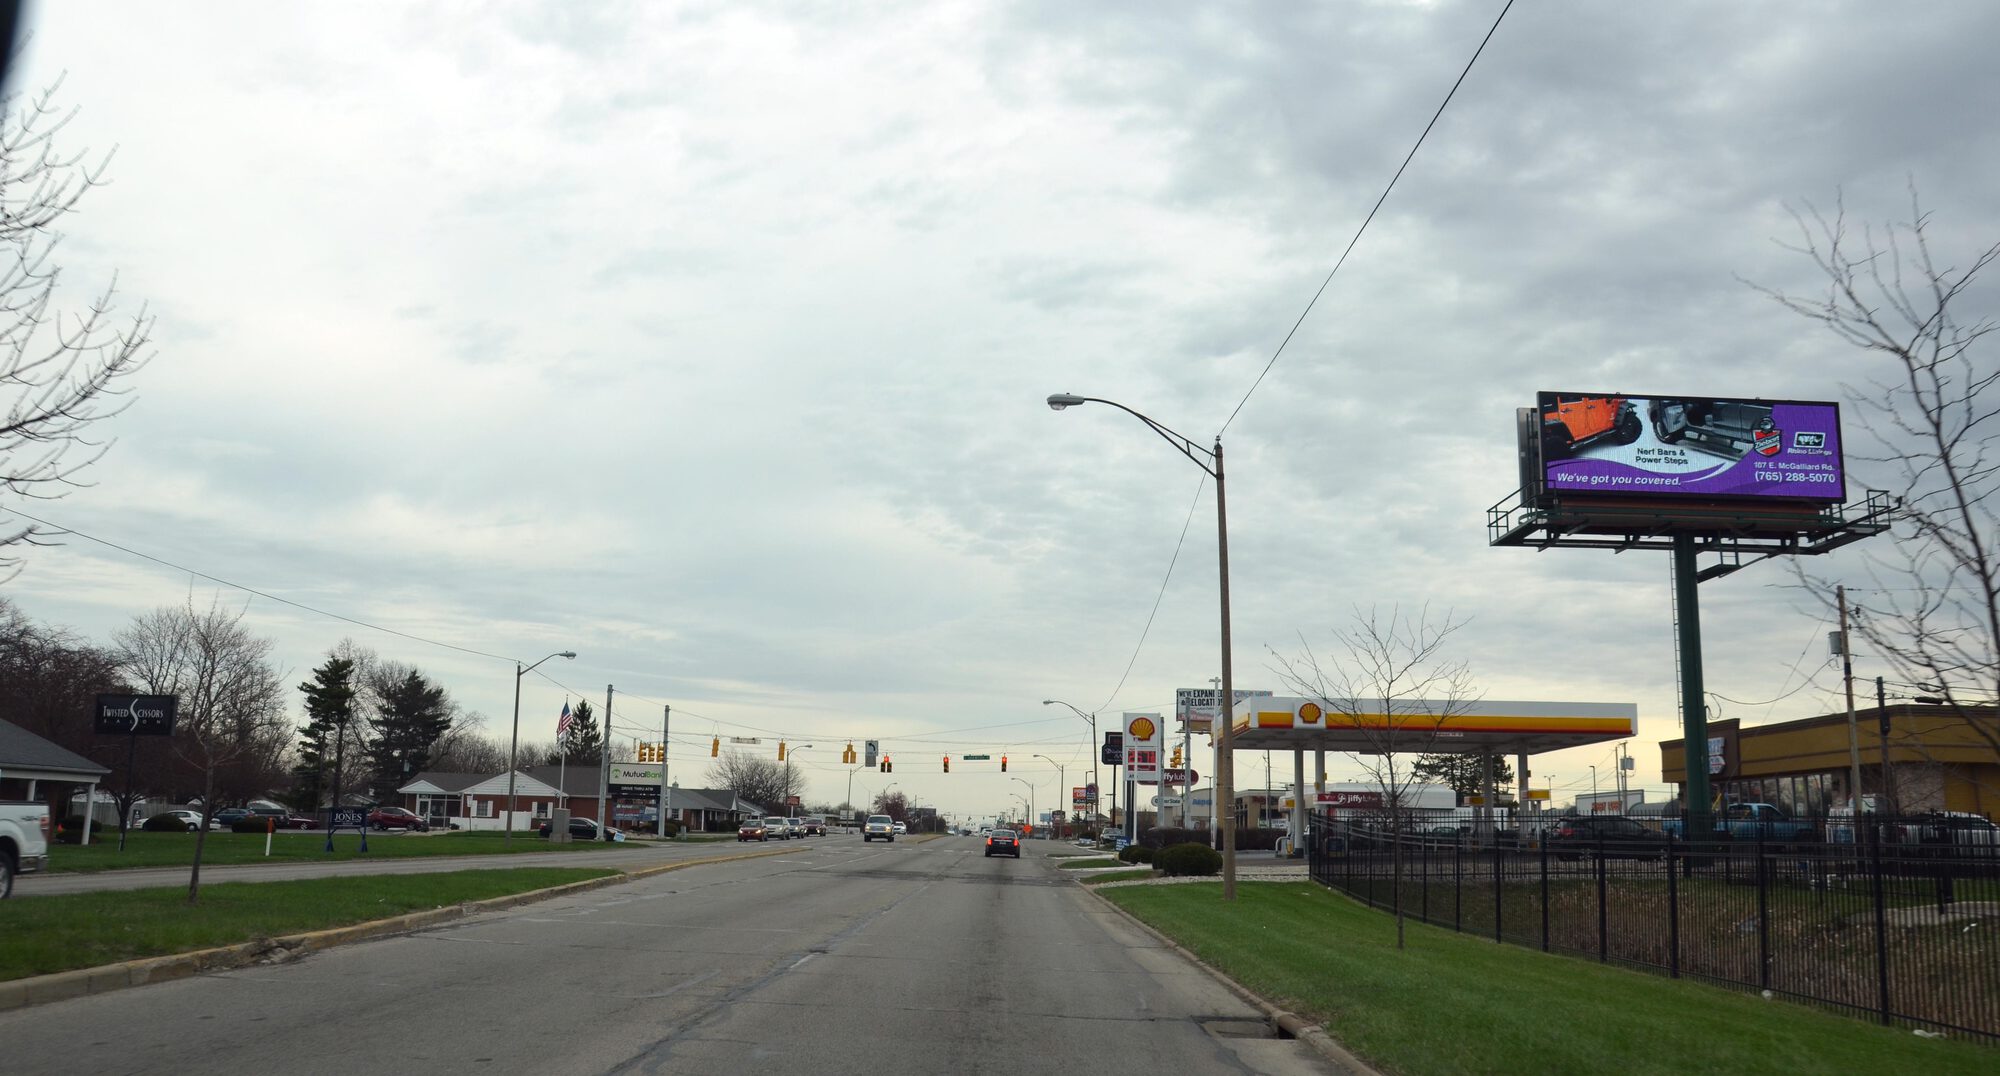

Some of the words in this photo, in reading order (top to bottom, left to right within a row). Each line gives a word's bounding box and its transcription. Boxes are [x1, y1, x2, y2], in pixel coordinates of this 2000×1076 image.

[1637, 447, 1655, 455] Nerf
[1658, 448, 1677, 456] Bars
[1635, 456, 1662, 464] Power
[1664, 457, 1689, 465] Steps
[1557, 472, 1589, 482] We've
[1591, 474, 1609, 485] got
[1611, 475, 1632, 485] you
[1634, 476, 1682, 486] covered.
[1755, 470, 1783, 482] (765)
[1785, 472, 1836, 483] 288-5070
[335, 813, 362, 821] JONES
